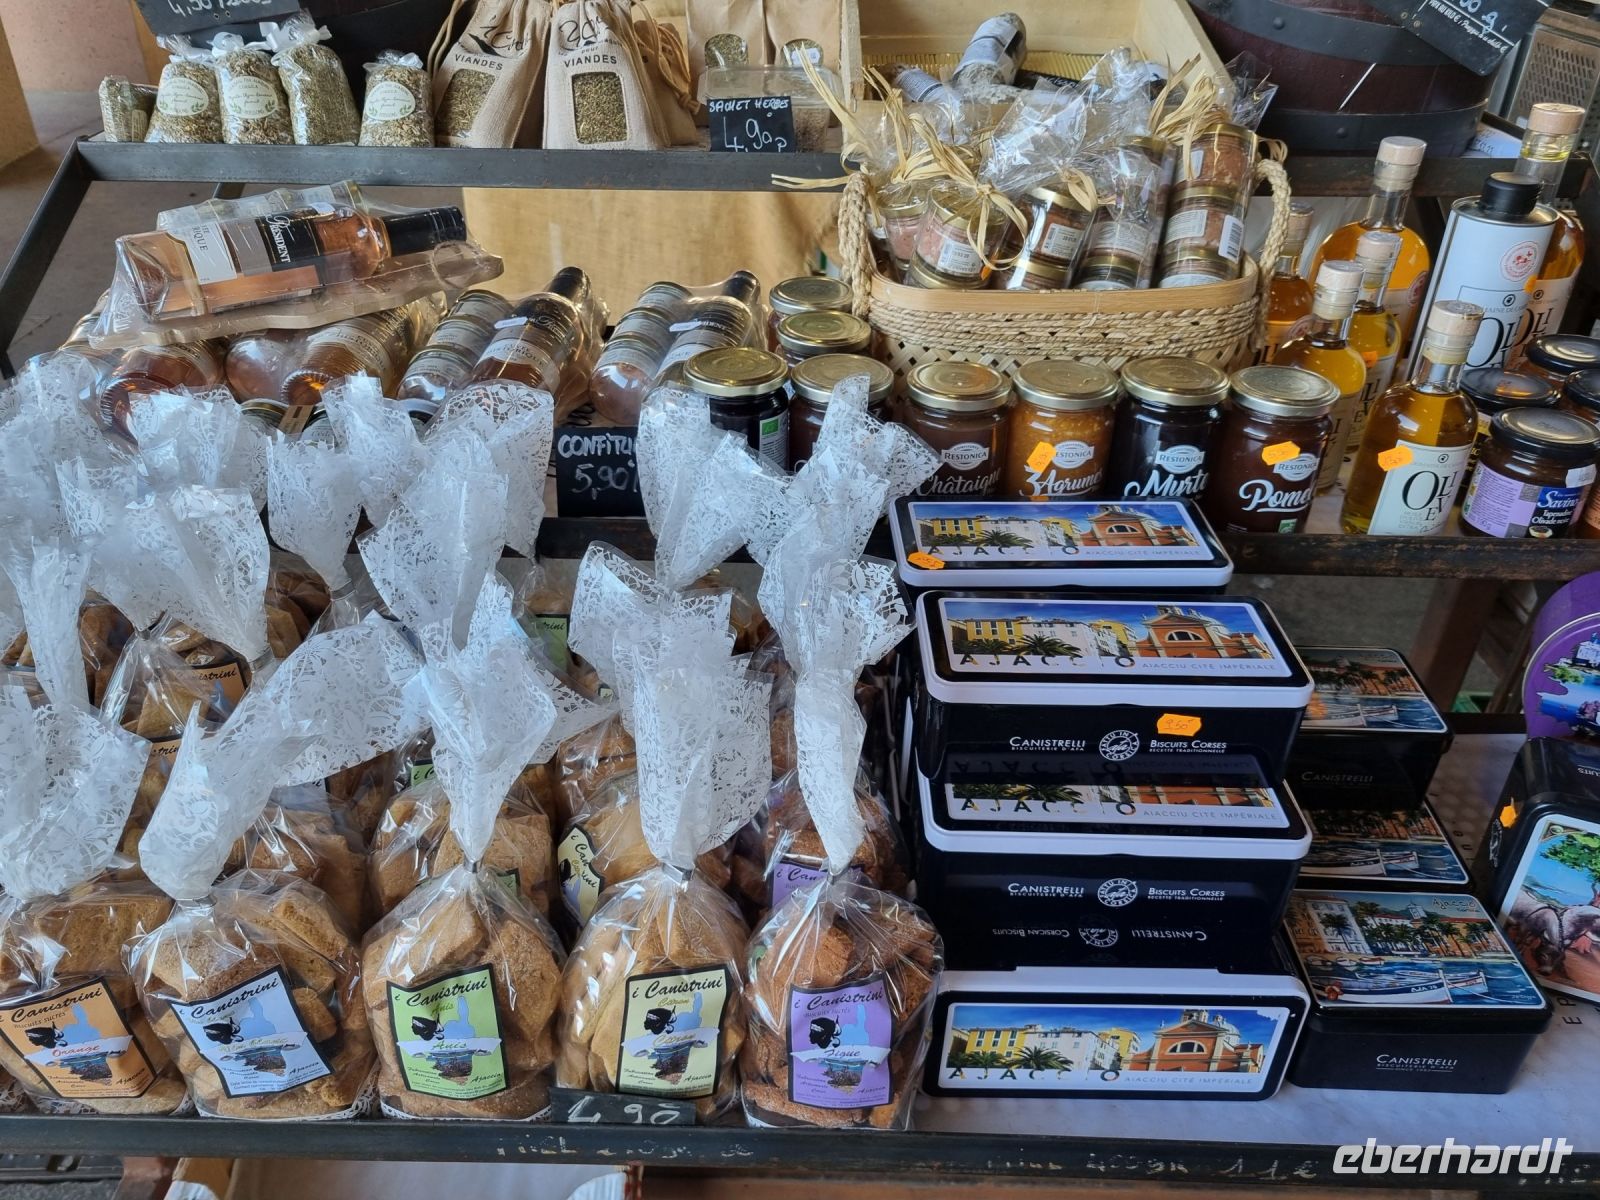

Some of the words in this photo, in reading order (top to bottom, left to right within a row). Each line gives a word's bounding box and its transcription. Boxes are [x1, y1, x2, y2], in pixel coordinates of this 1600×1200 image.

[455, 54, 503, 71] VIANDES
[564, 54, 617, 68] VIANDES
[709, 100, 751, 113] SACHET
[945, 452, 987, 461] RESTONICA
[1055, 450, 1093, 459] ESTONICA
[1009, 736, 1086, 748] CANISTRELLI
[1150, 740, 1187, 748] BISCUITS
[1191, 740, 1227, 749] CORSES
[1008, 882, 1084, 894] CANISTRELLI
[1149, 887, 1186, 896] BISCUITS
[1190, 888, 1225, 897] CORSES
[992, 928, 1026, 937] BISCUITS
[1028, 929, 1070, 937] CORSICAN
[1131, 929, 1207, 941] CANISTRELLI
[407, 976, 488, 1007] Canistrini
[645, 976, 723, 999] Canistrini
[191, 978, 279, 1018] Canistrini
[807, 987, 883, 1010] Canistrini
[11, 988, 103, 1023] Canistrini
[432, 1040, 467, 1050] Anis
[52, 1046, 100, 1057] Orange
[824, 1048, 861, 1057] Figue
[1376, 1054, 1458, 1066] CANISTRELLI
